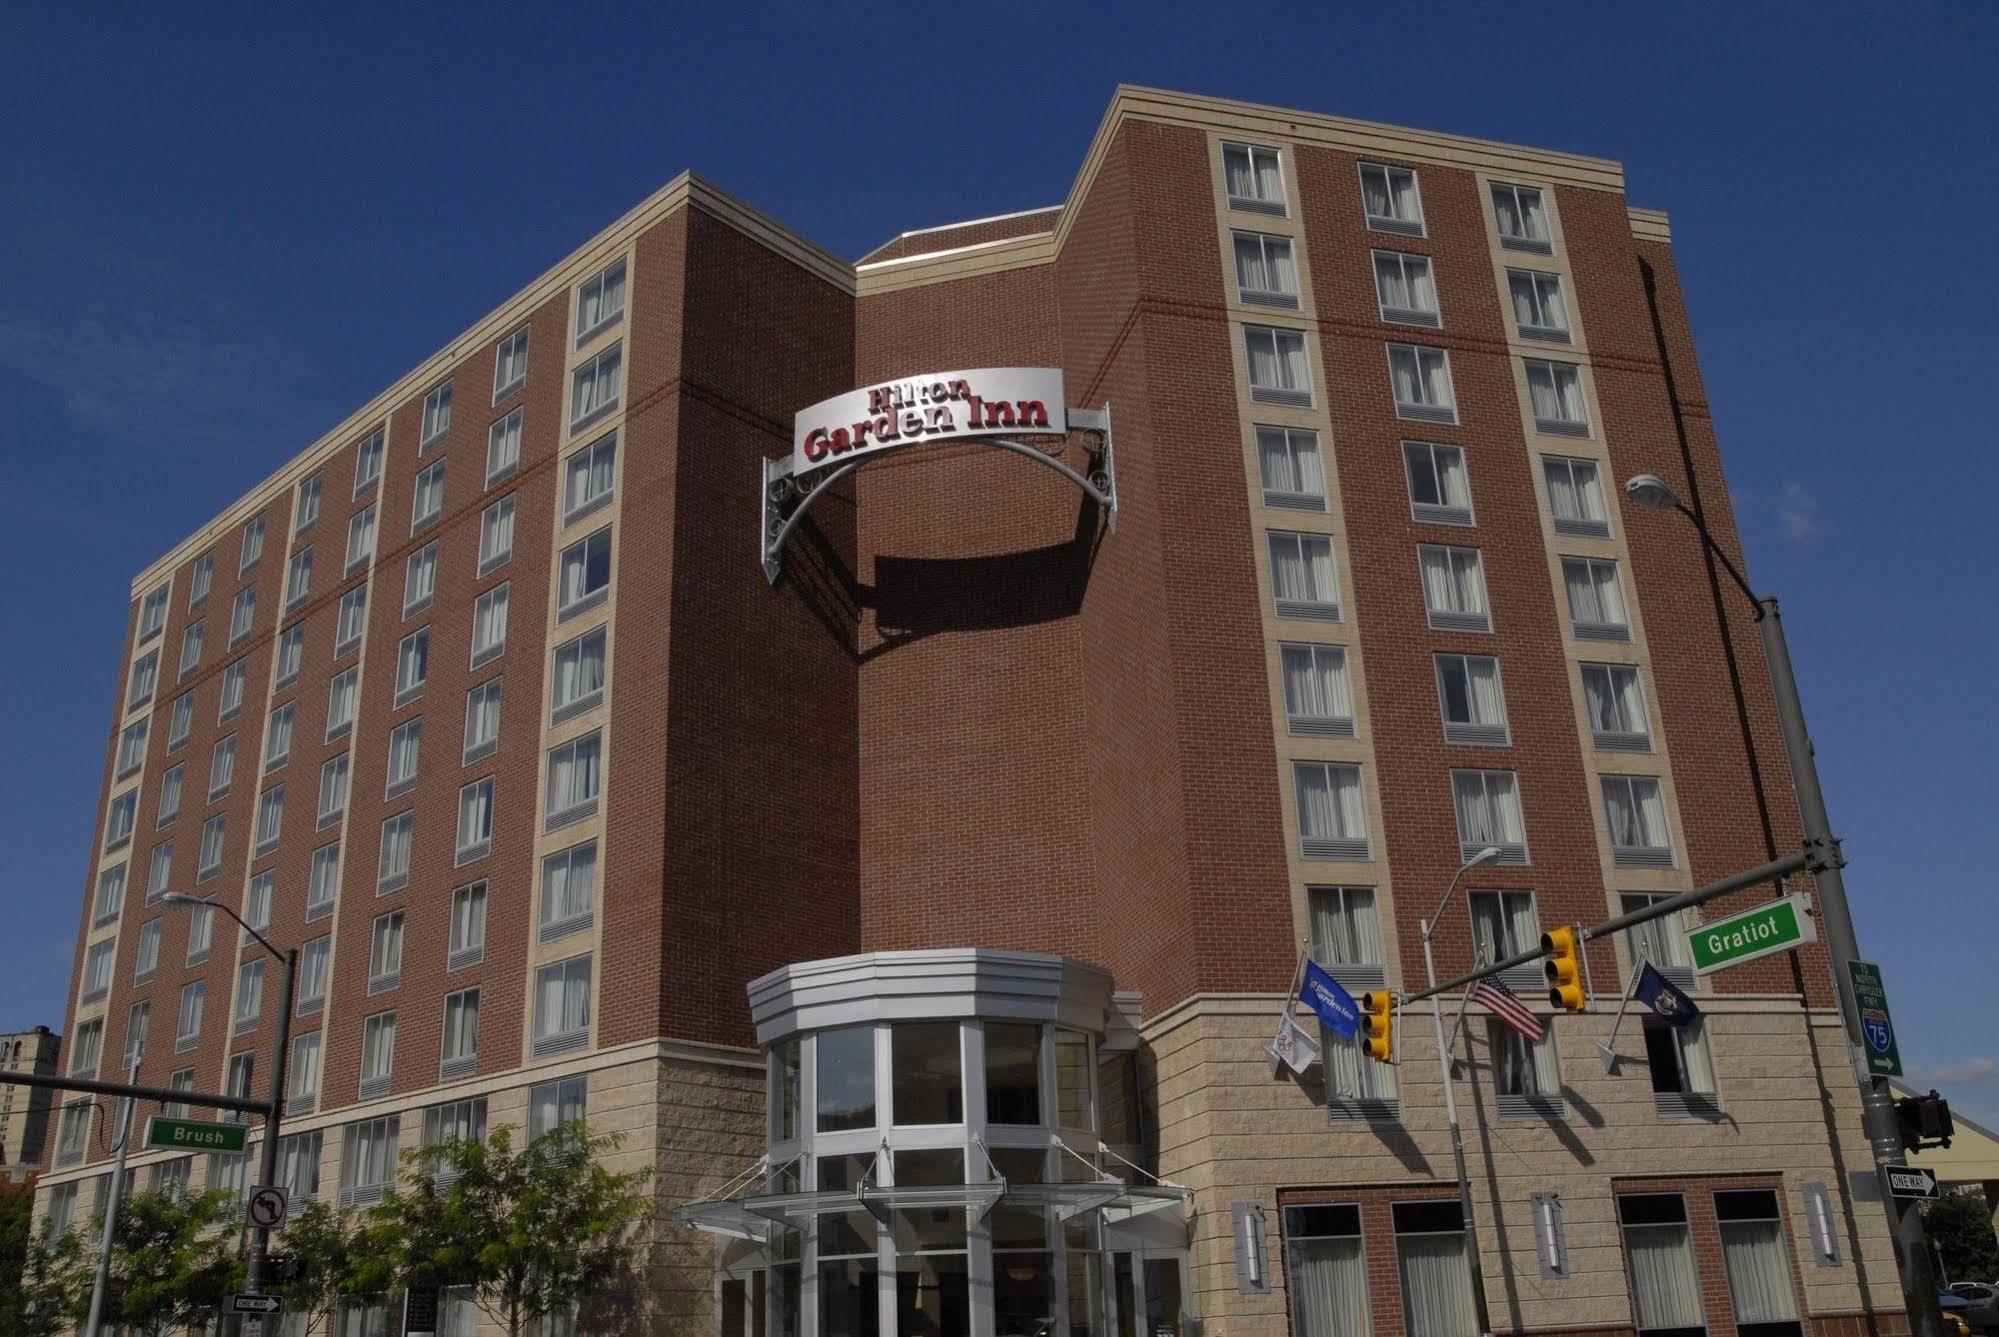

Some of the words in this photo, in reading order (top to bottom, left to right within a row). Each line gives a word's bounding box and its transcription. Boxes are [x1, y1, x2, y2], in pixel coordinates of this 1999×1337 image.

[868, 379, 971, 414] Hilton
[804, 404, 956, 462] Garden
[967, 395, 1051, 430] Inn
[1708, 917, 1779, 954] Gratiot
[1316, 988, 1342, 1011] Garden
[1869, 1025, 1887, 1044] 75
[174, 1127, 224, 1144] Brush
[1893, 1175, 1909, 1188] ONE
[1909, 1176, 1924, 1189] WAY
[239, 1299, 255, 1308] ONE
[256, 1299, 269, 1309] WAY
